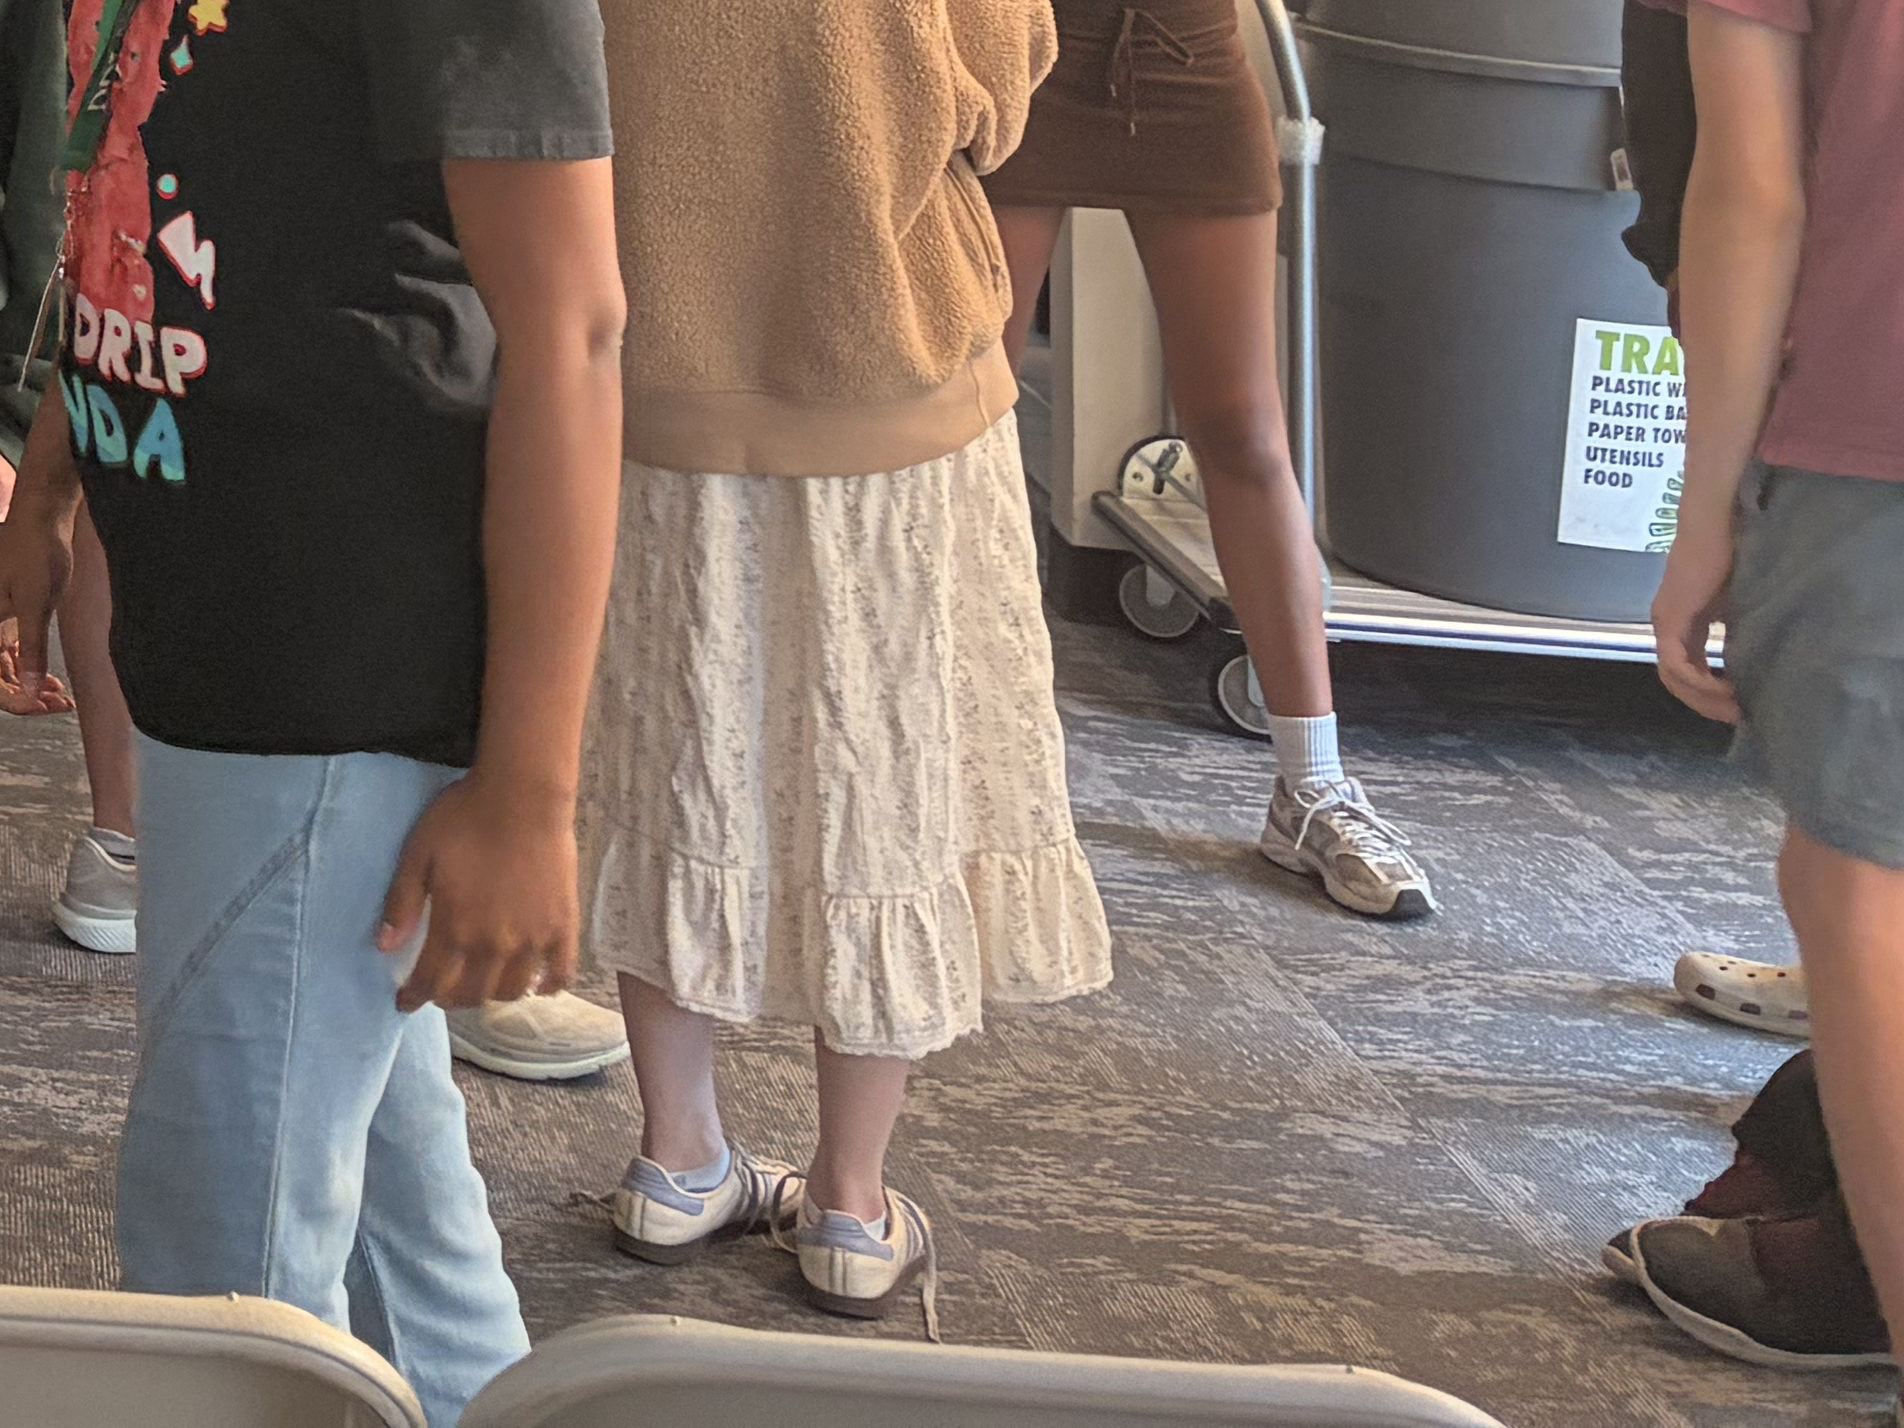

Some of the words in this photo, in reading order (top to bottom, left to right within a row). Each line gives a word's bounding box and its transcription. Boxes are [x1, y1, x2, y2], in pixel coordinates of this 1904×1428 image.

[73, 292, 209, 399] DRIP
[1590, 375, 1662, 397] PLASTIC
[1667, 381, 1687, 398] W
[1588, 398, 1660, 420] PLASTIC
[1587, 422, 1646, 443] PAPER
[1585, 446, 1665, 468] UTENSILS
[1583, 468, 1634, 489] FOOD
